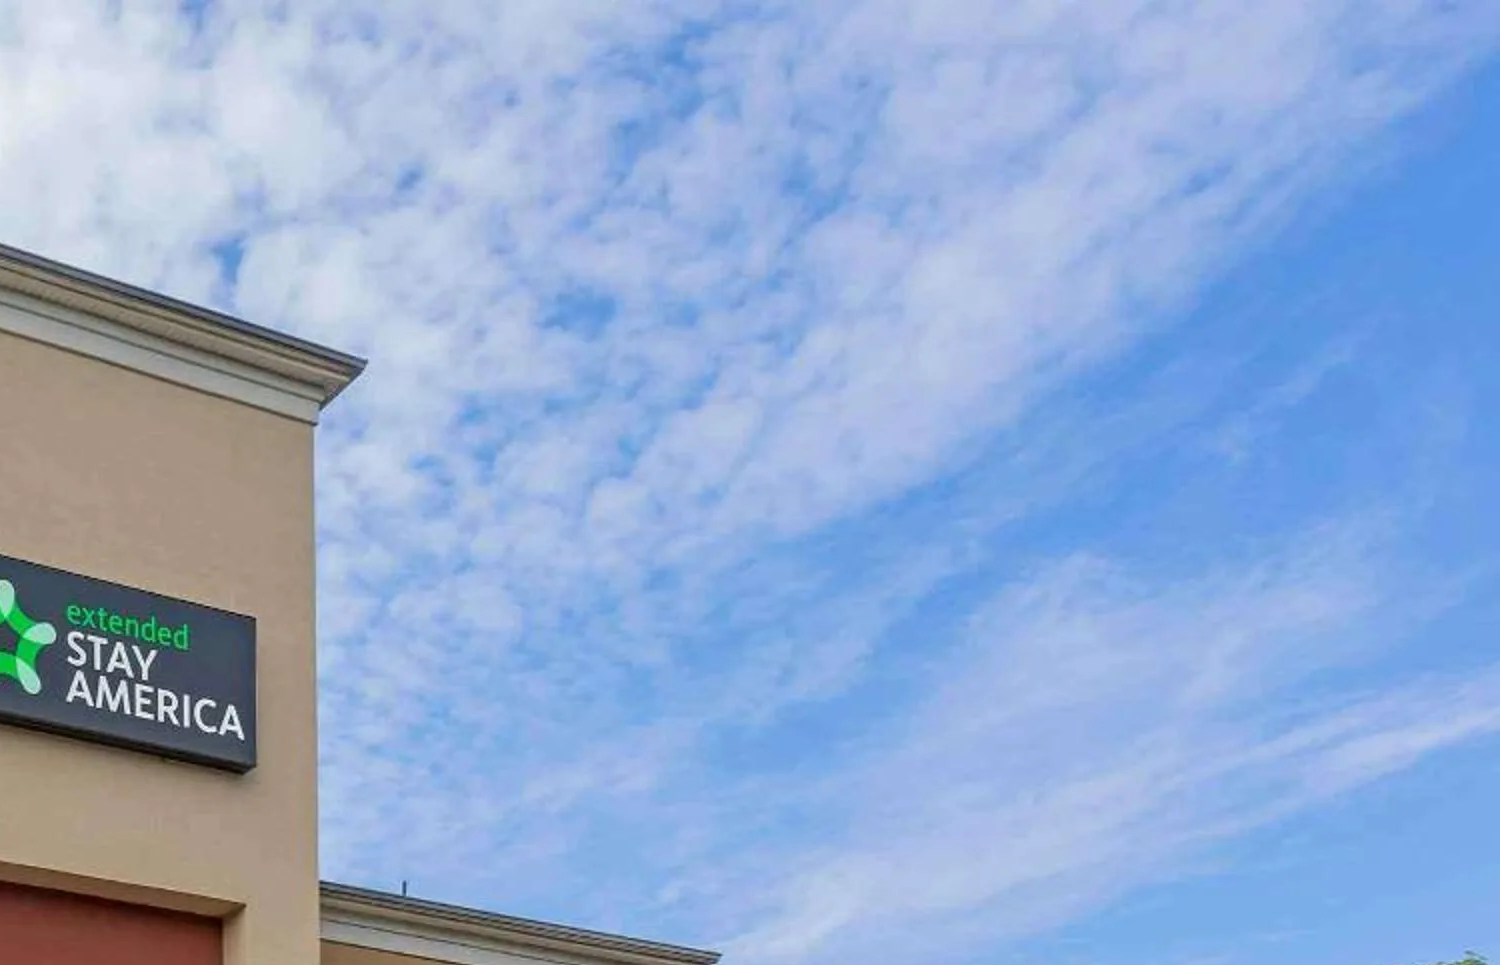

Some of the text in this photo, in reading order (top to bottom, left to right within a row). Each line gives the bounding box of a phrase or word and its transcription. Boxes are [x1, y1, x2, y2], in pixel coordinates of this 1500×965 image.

[66, 605, 189, 650] extended
[67, 631, 158, 681] STAY
[66, 670, 245, 741] AMERICA
